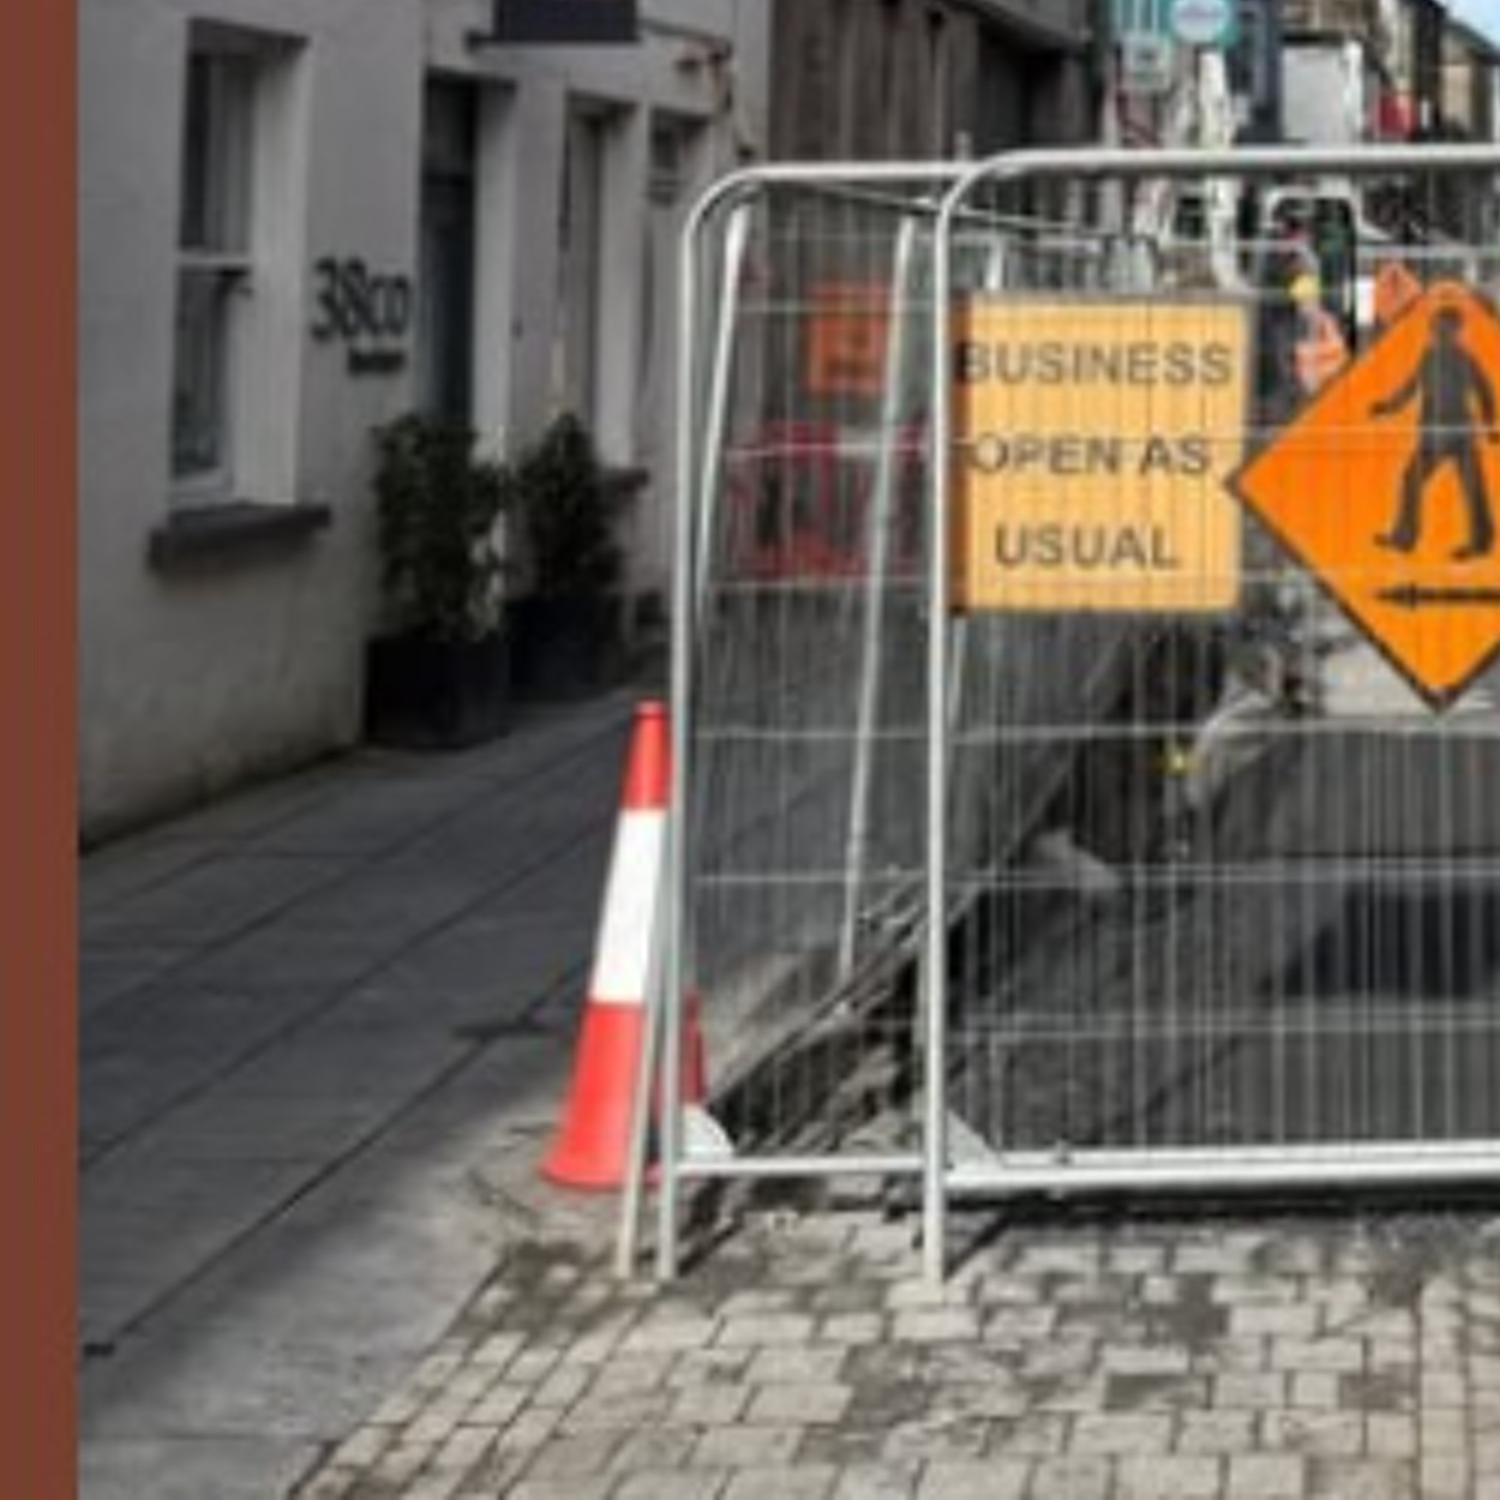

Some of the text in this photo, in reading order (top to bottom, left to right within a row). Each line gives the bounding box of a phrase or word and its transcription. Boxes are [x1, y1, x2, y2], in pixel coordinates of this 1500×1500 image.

[955, 341, 1234, 386] BUSINESS
[964, 434, 1212, 476] OPEN AS
[994, 523, 1181, 570] USUAL
